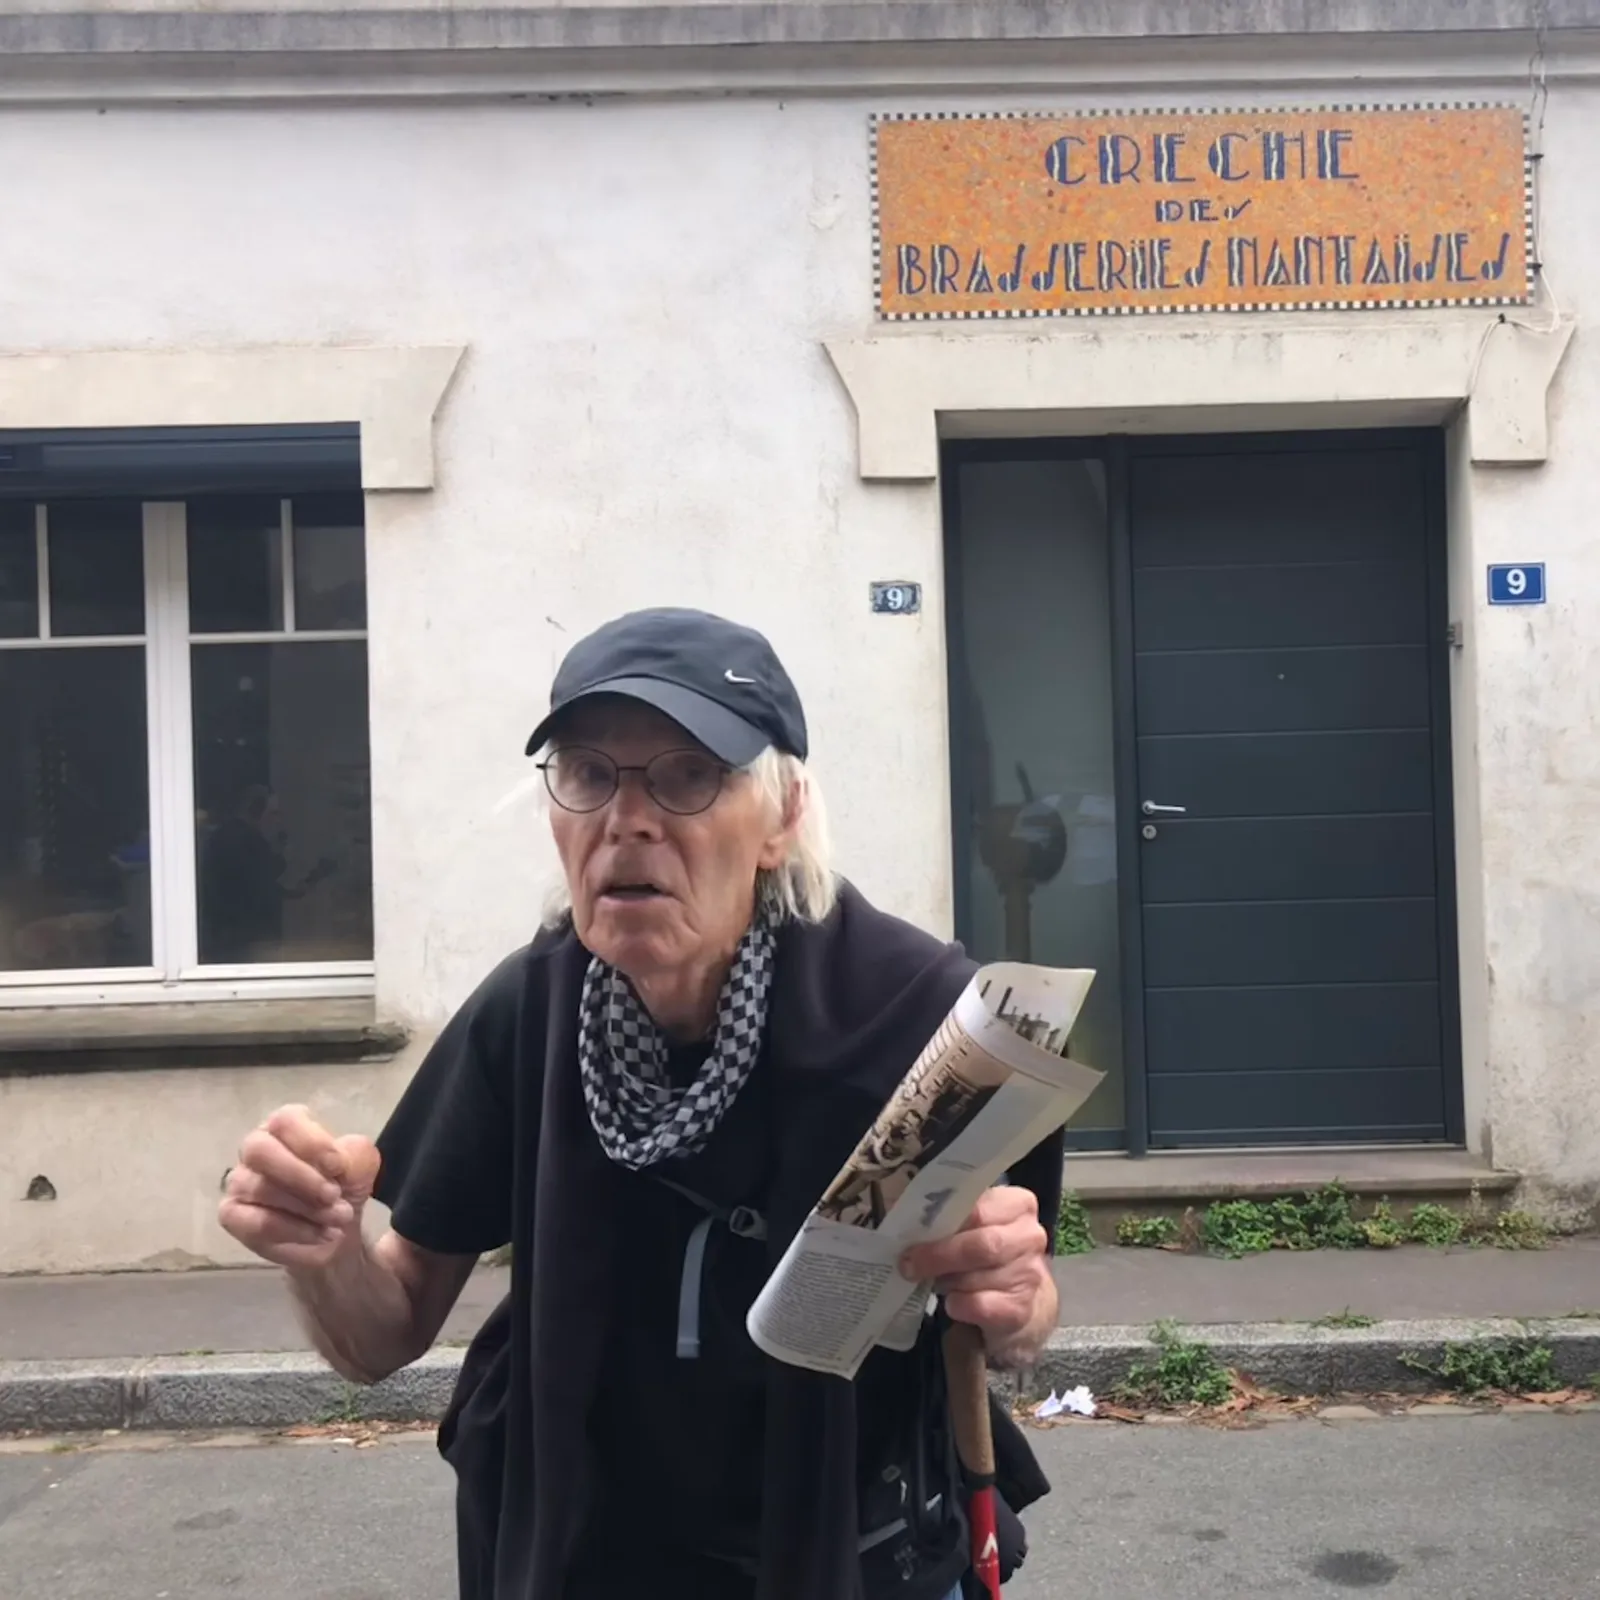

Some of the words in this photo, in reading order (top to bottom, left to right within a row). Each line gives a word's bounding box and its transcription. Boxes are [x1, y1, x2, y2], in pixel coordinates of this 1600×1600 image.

[1045, 130, 1360, 184] CRECHE
[1155, 199, 1252, 222] DES
[897, 238, 1211, 295] BRASSERIES
[1227, 232, 1510, 287] NANTAISES
[1506, 568, 1527, 595] 9
[886, 587, 902, 610] 9
